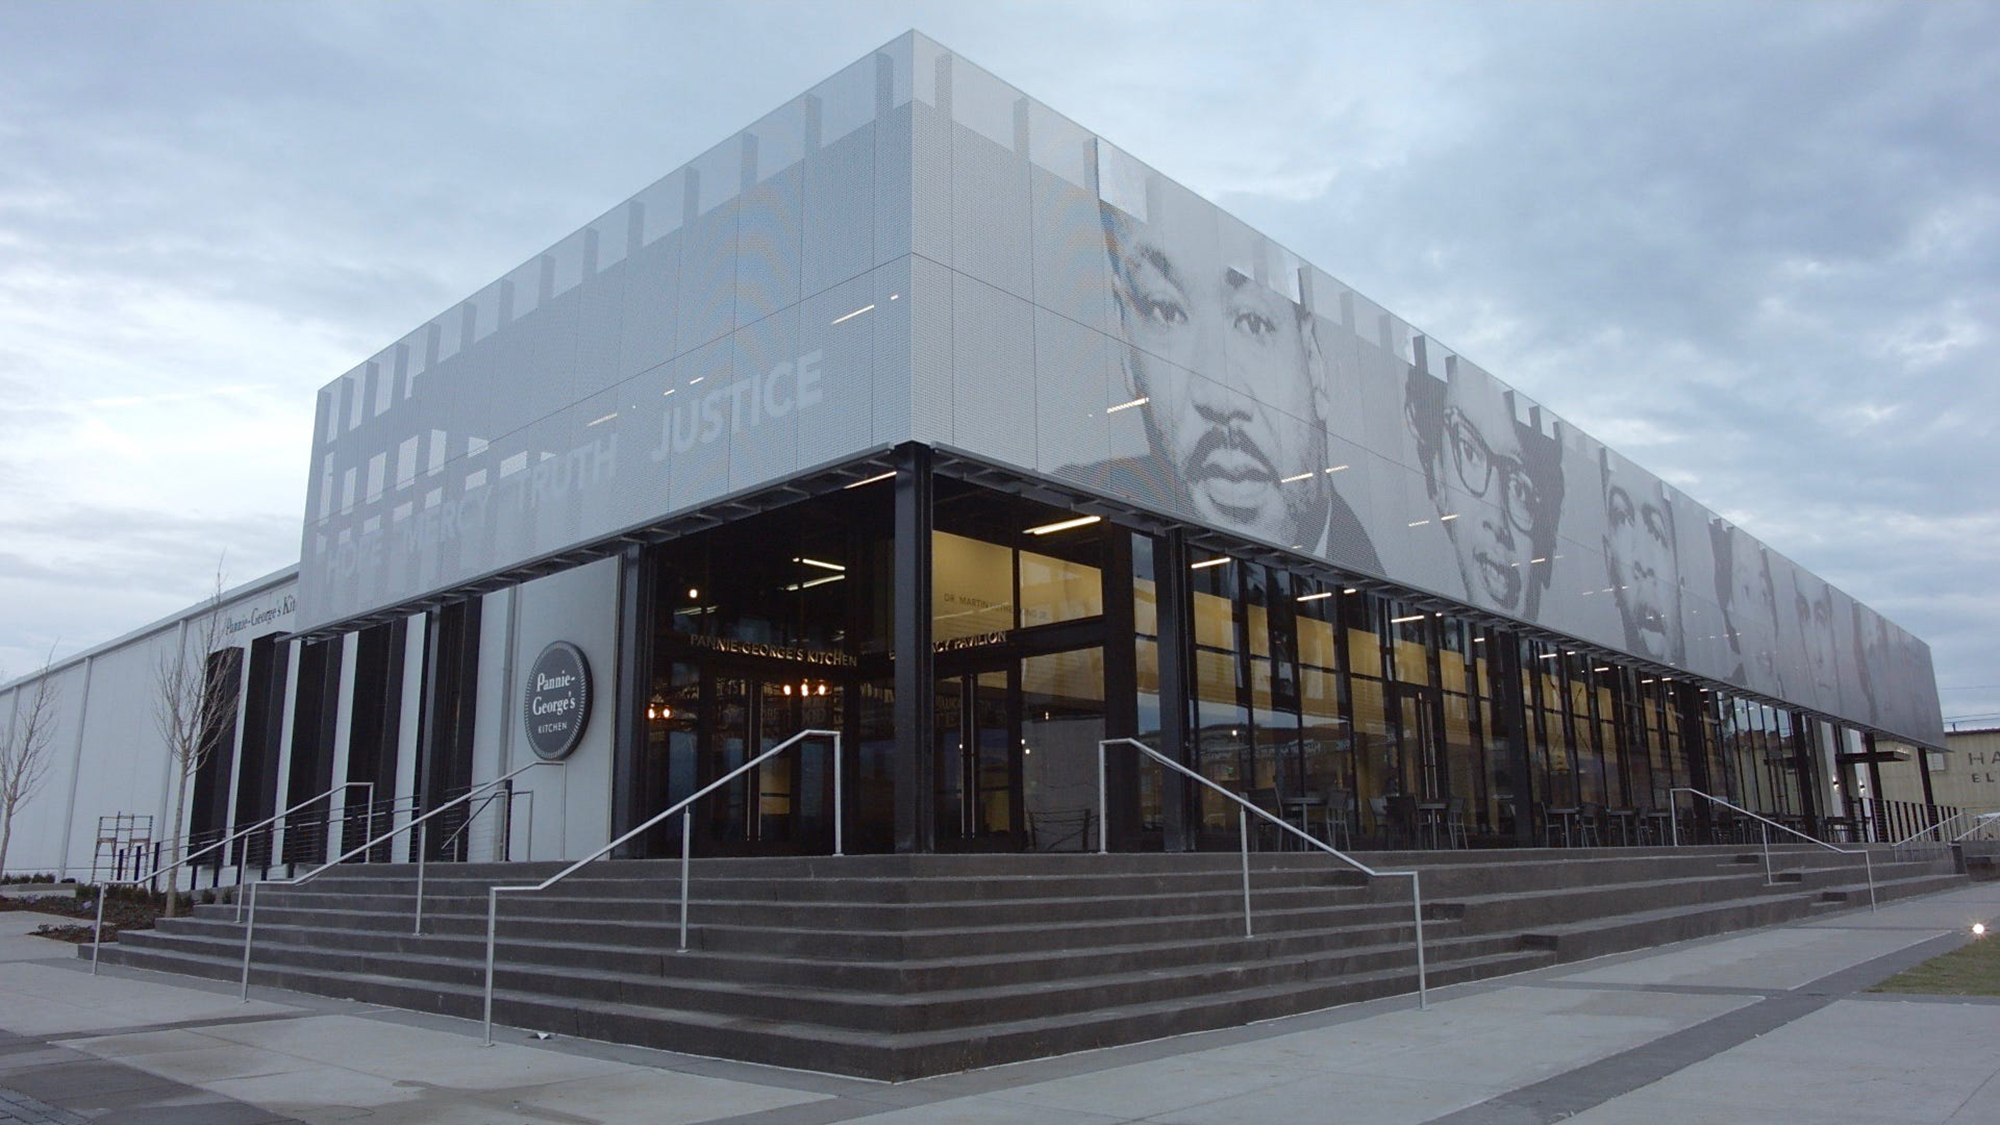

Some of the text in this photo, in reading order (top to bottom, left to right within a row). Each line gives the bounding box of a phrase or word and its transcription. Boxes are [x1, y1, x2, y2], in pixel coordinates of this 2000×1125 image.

[402, 485, 494, 554] MERCY
[511, 431, 618, 513] TRUTH
[651, 347, 823, 463] JUSTICE
[959, 596, 989, 608] MARTIN
[953, 631, 1007, 649] PAVILION
[807, 649, 857, 667] KITCHEN
[536, 670, 576, 692] Pannie-
[532, 691, 576, 716] George's
[537, 721, 568, 734] KITCHEN
